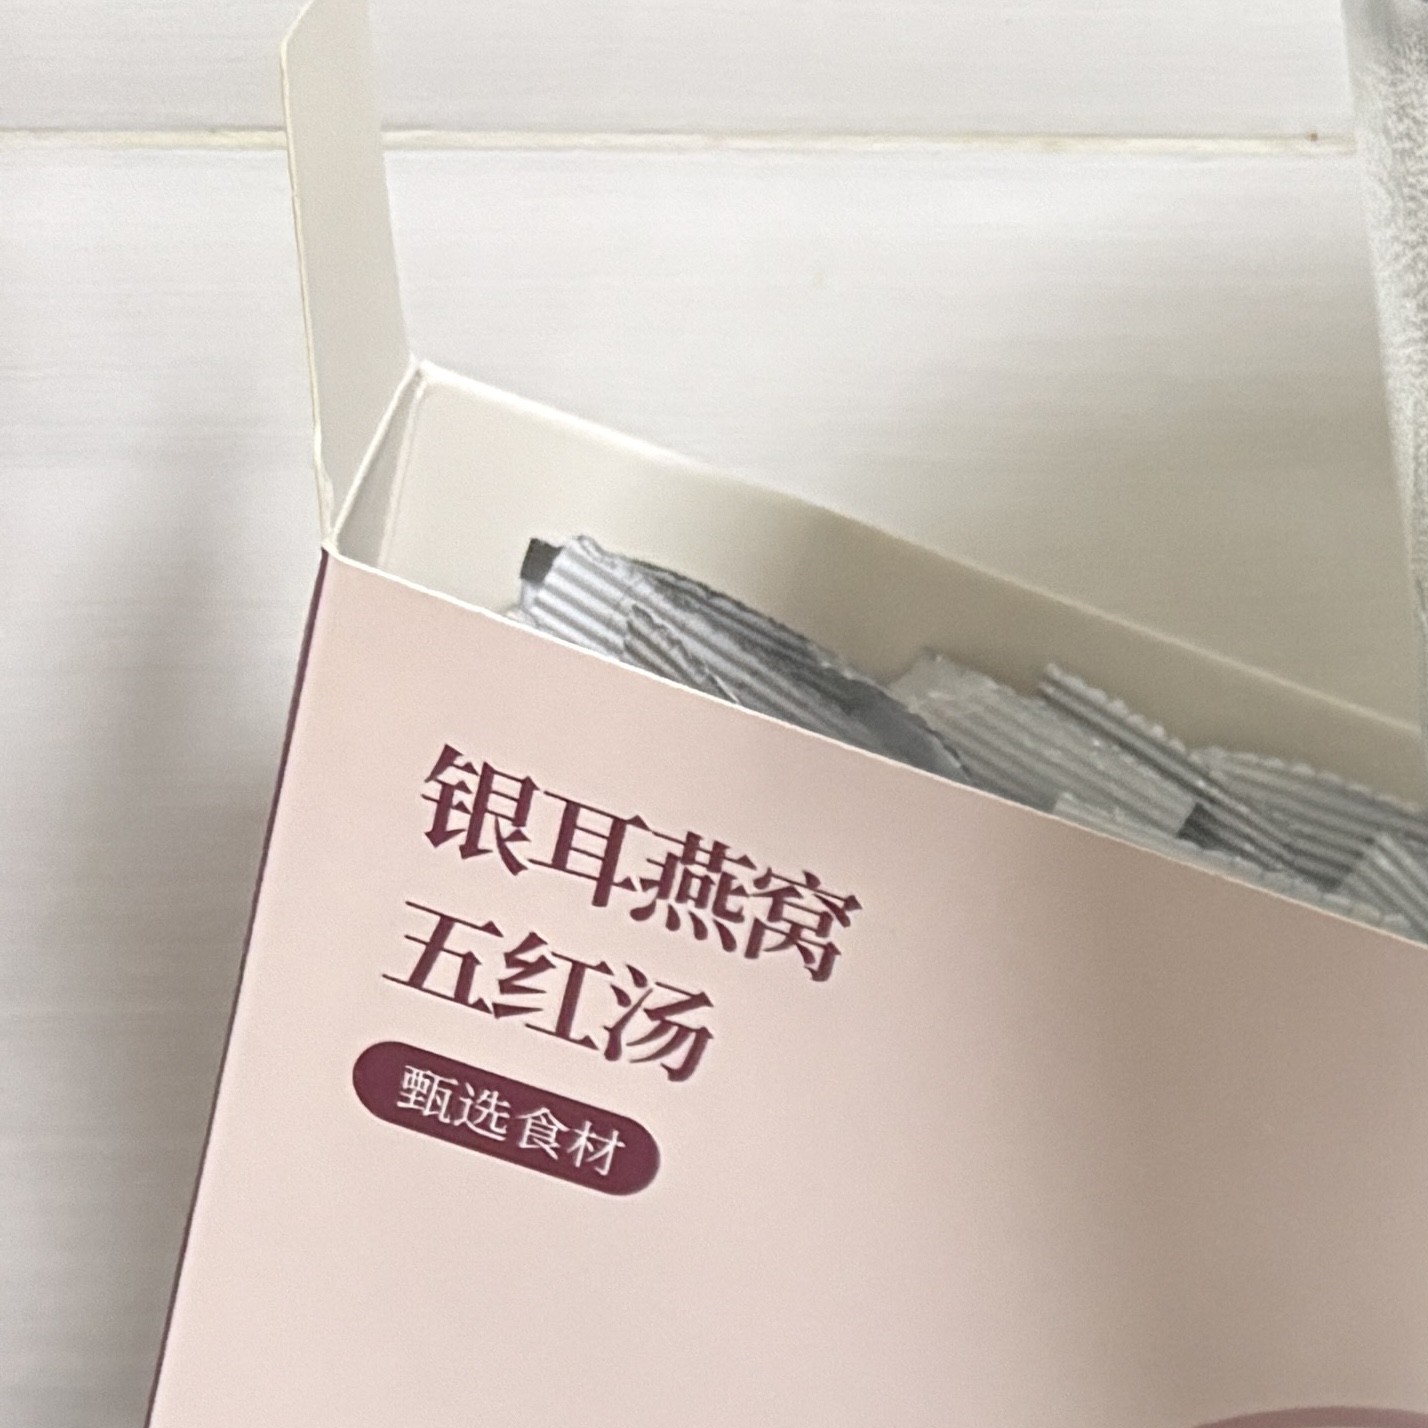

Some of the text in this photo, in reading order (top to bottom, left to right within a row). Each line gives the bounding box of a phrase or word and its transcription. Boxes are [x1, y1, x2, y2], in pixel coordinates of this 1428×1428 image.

[421, 743, 863, 983] 银耳燕窝
[381, 900, 716, 1083] 五红汤
[396, 1064, 626, 1178] 甄选食材
